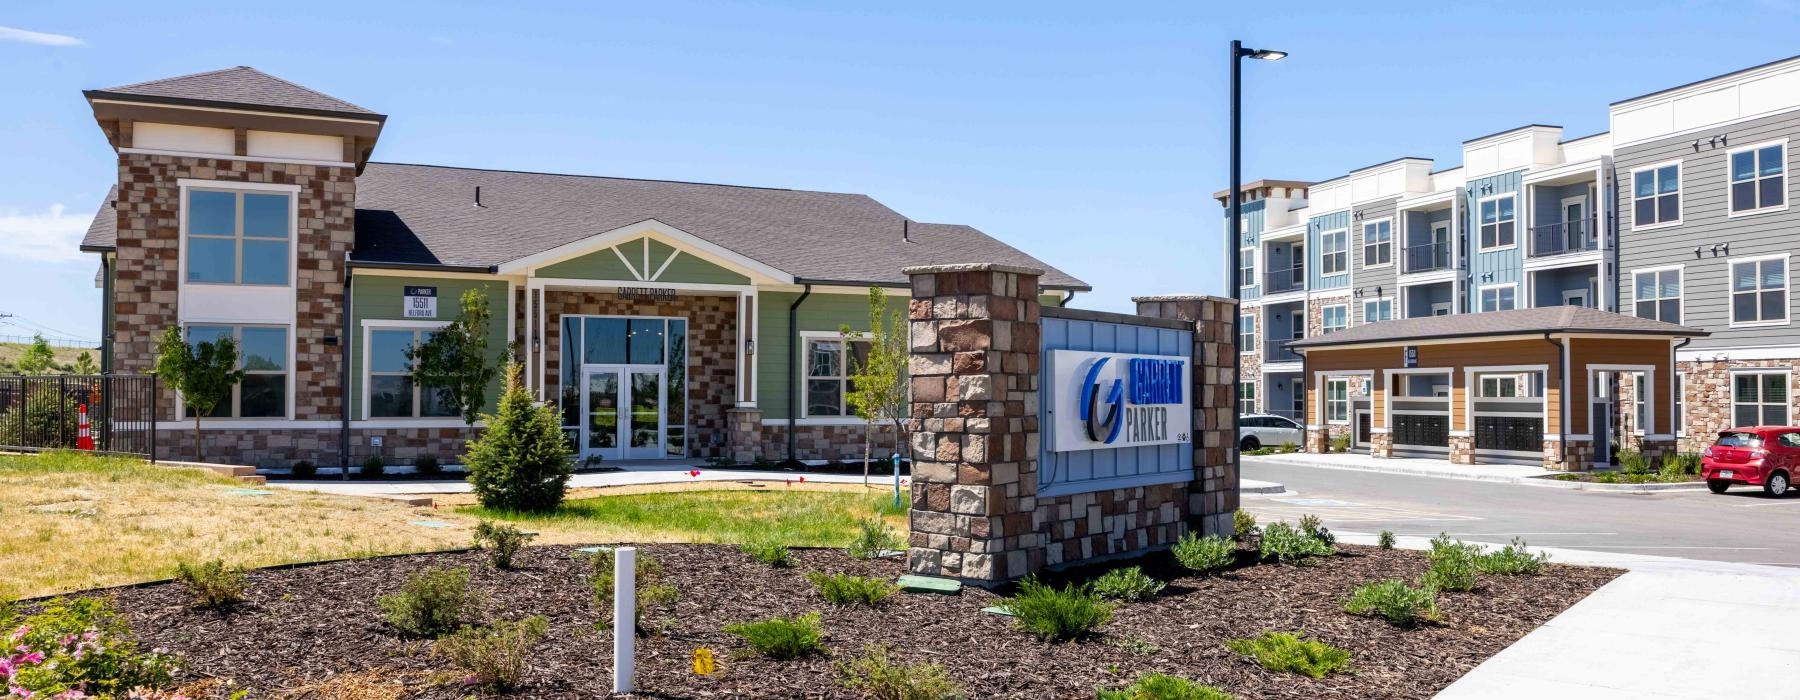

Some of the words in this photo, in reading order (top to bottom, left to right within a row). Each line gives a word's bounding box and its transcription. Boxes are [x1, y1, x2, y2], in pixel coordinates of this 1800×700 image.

[413, 297, 429, 309] 15511
[618, 287, 648, 301] GARRETT
[650, 288, 676, 303] PARKER
[1131, 358, 1184, 405] GARRETT
[1126, 407, 1168, 442] PARKER
